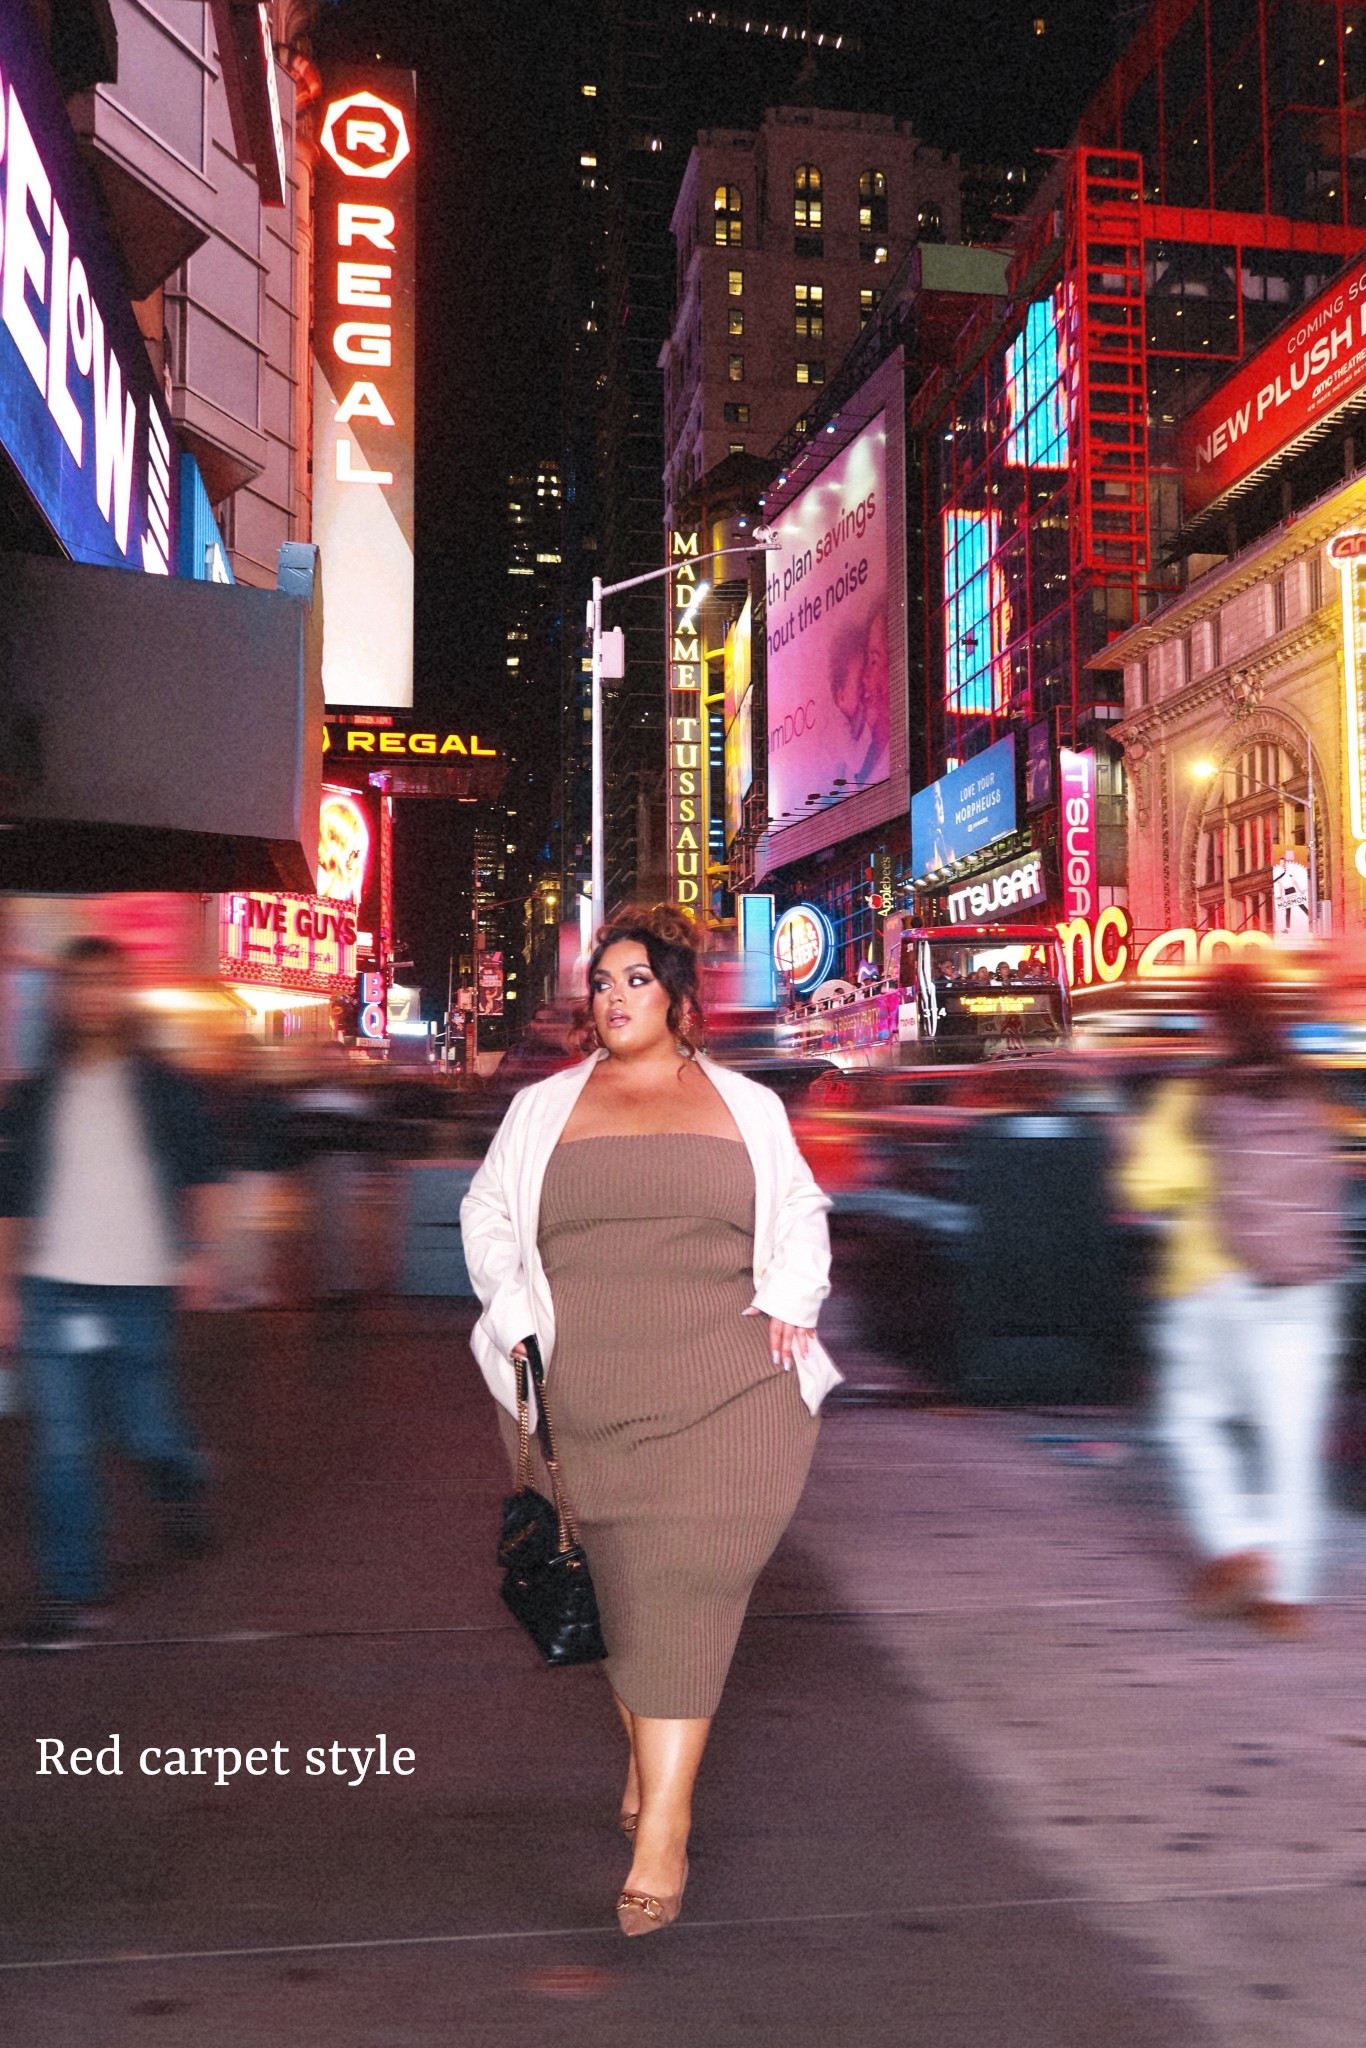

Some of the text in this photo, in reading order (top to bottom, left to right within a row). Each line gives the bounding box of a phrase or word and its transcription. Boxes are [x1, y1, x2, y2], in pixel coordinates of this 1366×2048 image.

[346, 119, 387, 154] R
[0, 68, 137, 557] ELOW
[1287, 296, 1345, 354] COMING
[332, 202, 396, 485] REGAL
[1195, 400, 1252, 473] NEW
[1257, 314, 1353, 423] PLUSH
[1311, 374, 1333, 399] amc
[784, 549, 812, 598] plan
[816, 491, 876, 564] savings
[673, 531, 699, 688] MADAME
[798, 596, 821, 633] the
[826, 557, 868, 612] noise
[347, 731, 497, 756] REGAL
[955, 788, 1001, 825] MORPHEUS8
[960, 772, 995, 802] LOVE YOUR
[878, 856, 894, 917] Applebee's
[948, 860, 1042, 924] IT'SUGAR
[1278, 896, 1307, 908] MORMON
[233, 896, 357, 945] FIVE GUYS
